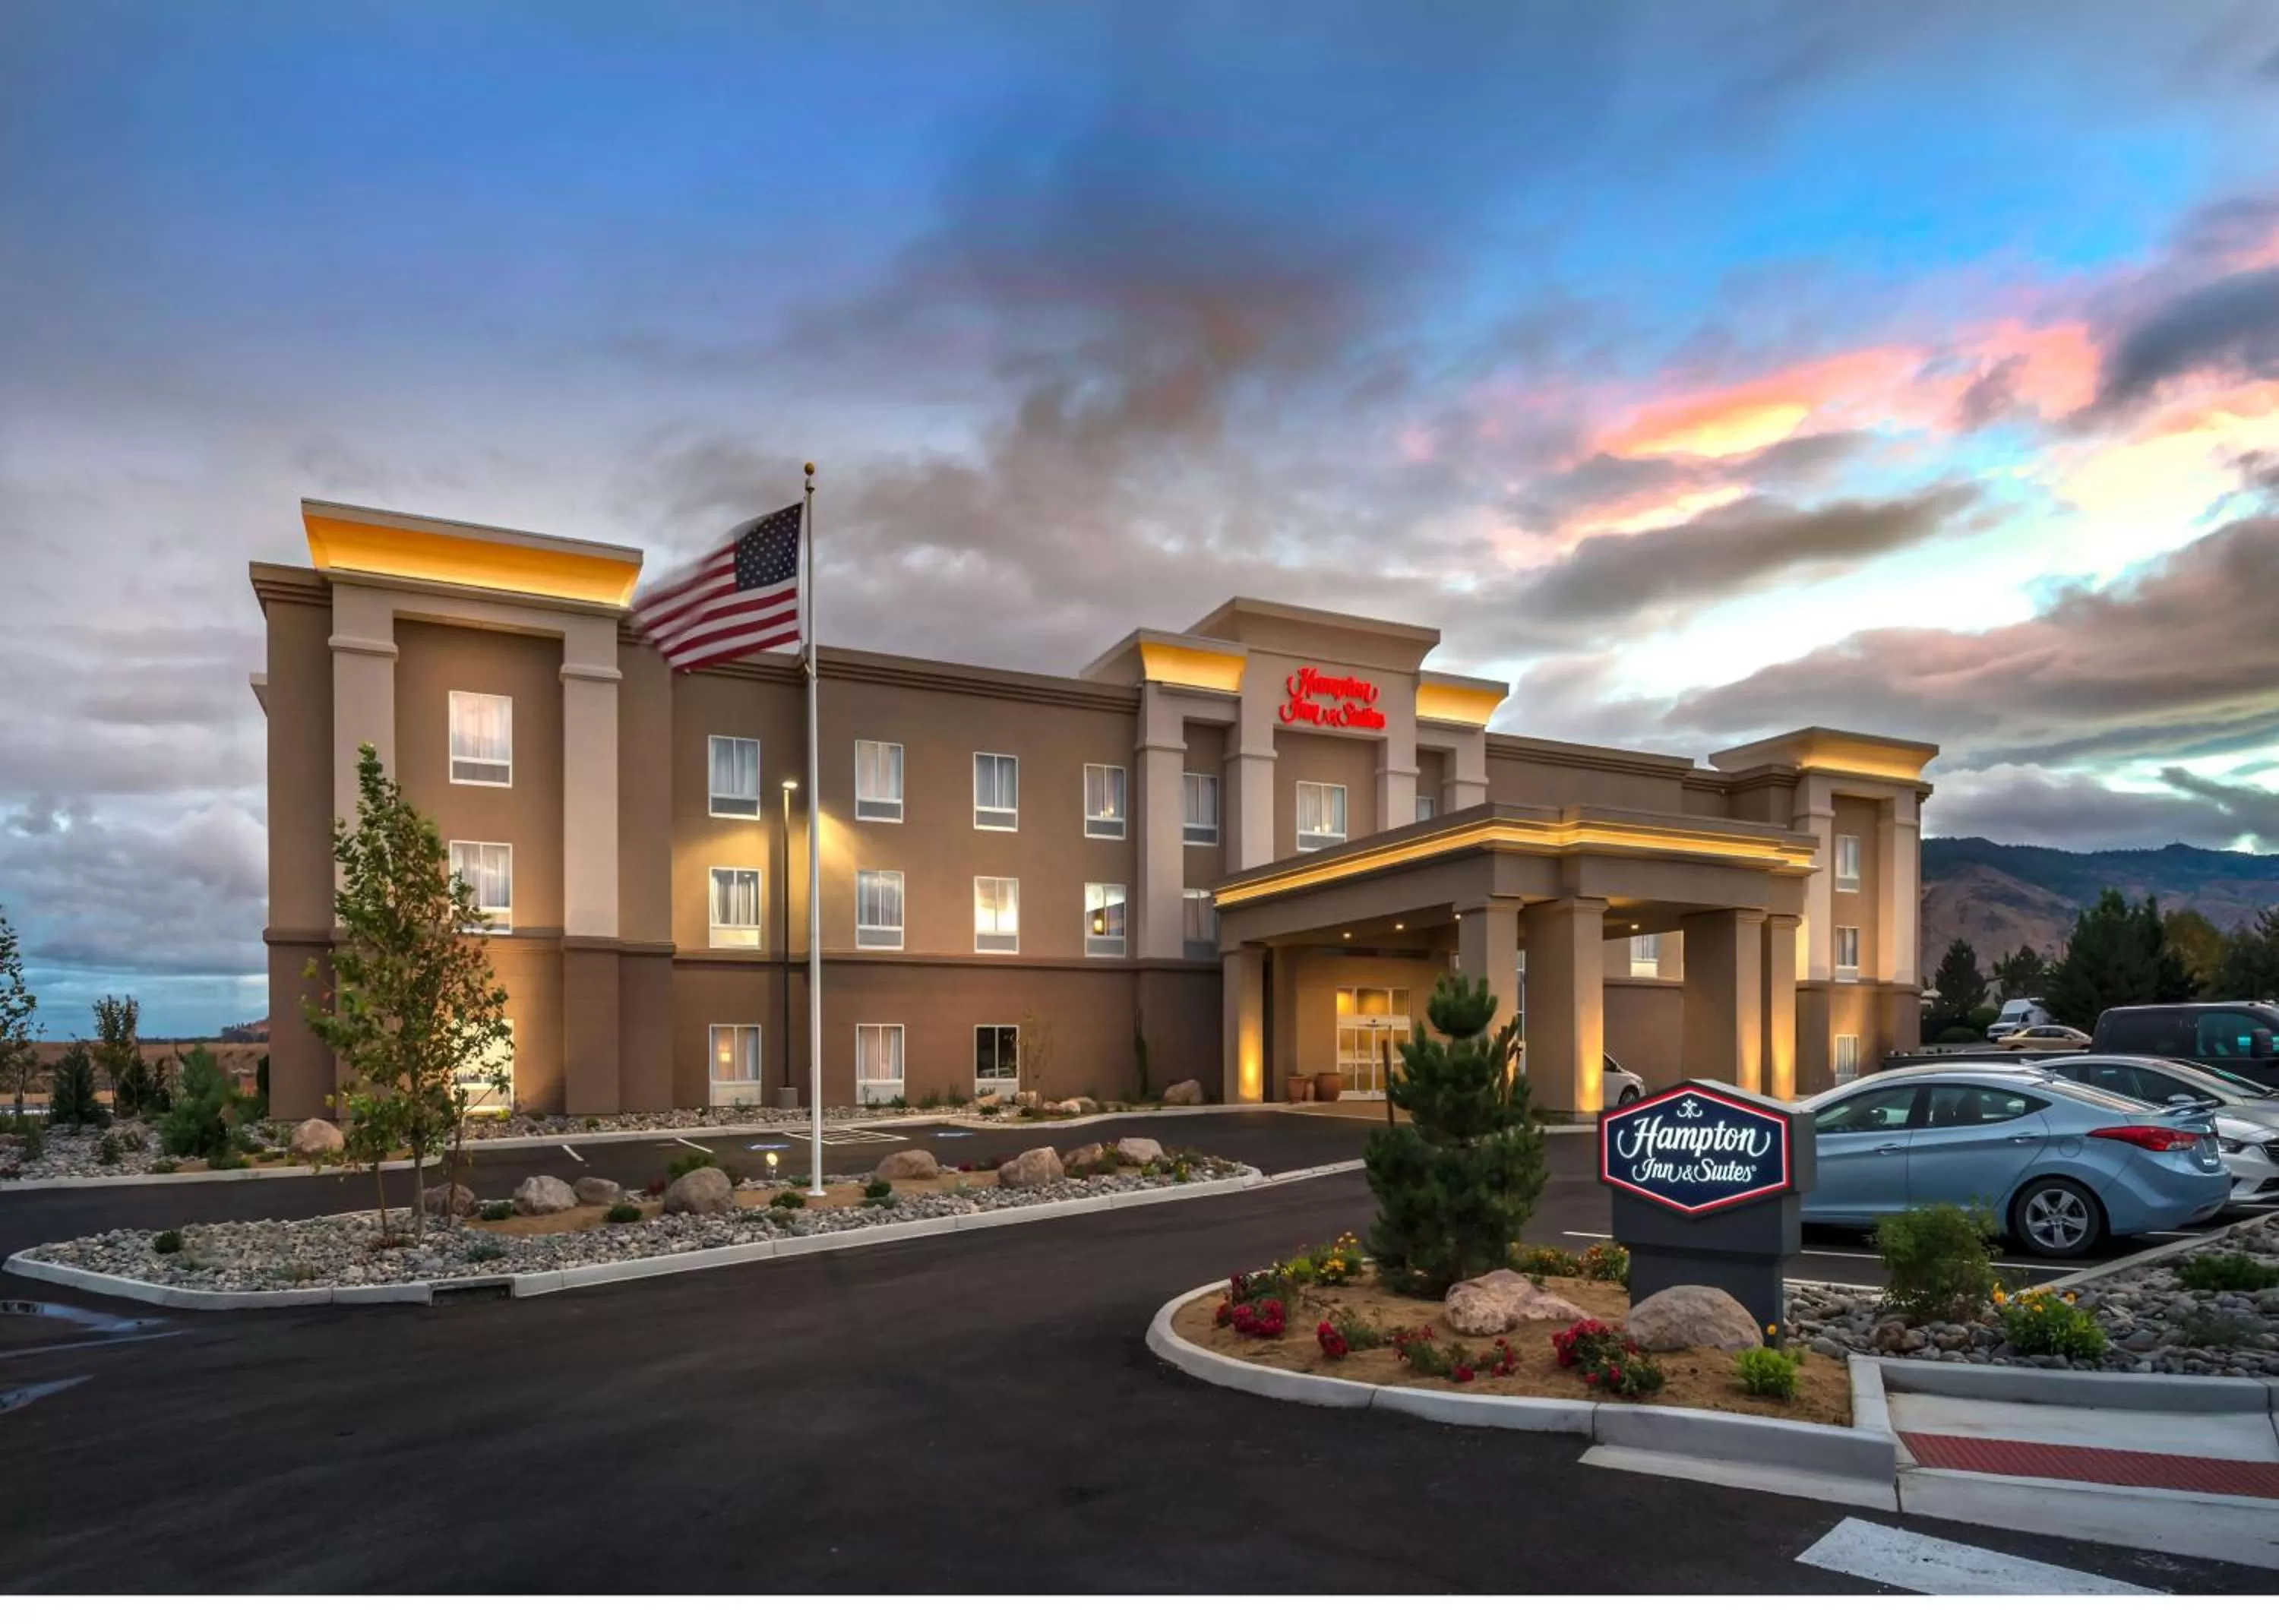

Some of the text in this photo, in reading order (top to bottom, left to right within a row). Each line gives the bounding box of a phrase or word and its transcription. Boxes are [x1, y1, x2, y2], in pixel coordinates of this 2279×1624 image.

[1287, 668, 1380, 703] Hampton
[1279, 698, 1324, 725] Inn
[1339, 701, 1386, 729] Suites
[1617, 1114, 1771, 1158] Hampton
[1632, 1157, 1682, 1183] Inn
[1682, 1165, 1696, 1183] &
